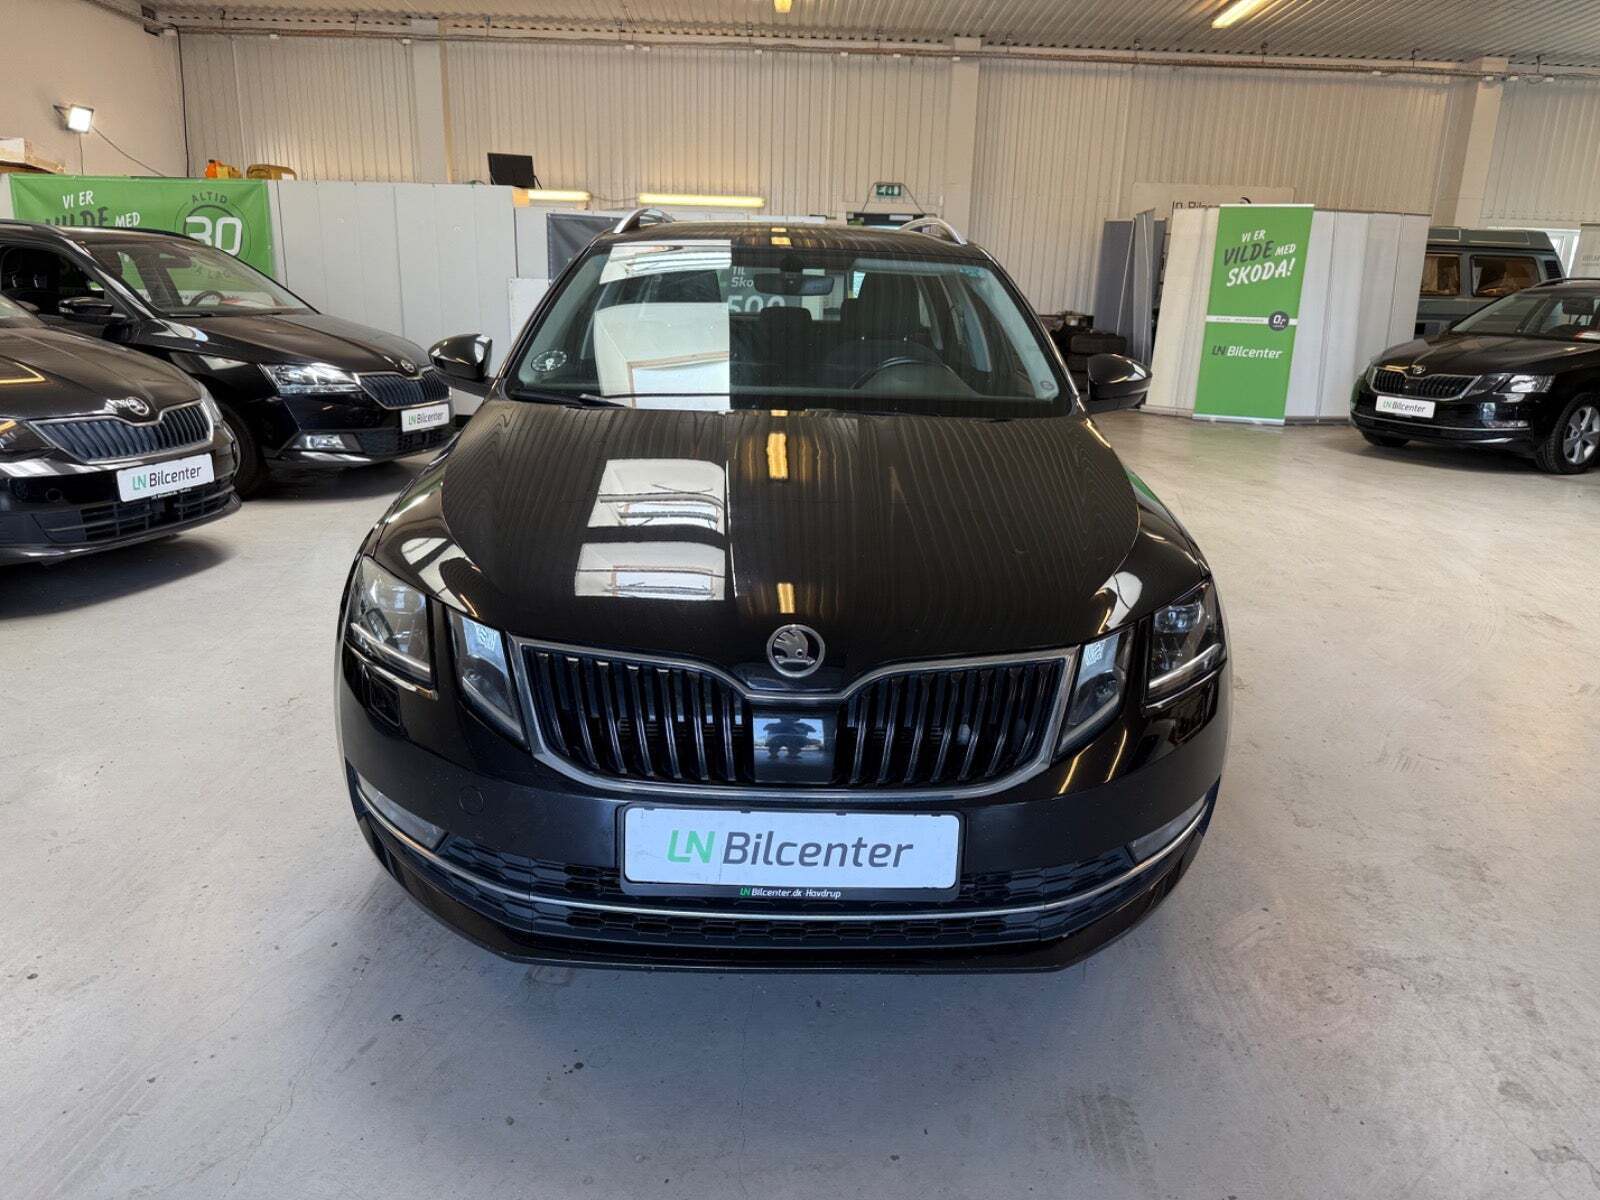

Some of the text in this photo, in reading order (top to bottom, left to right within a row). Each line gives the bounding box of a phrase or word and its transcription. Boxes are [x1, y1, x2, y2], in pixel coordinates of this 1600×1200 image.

[62, 190, 94, 209] VI ER
[192, 191, 228, 204] ALTID
[115, 211, 141, 228] MED
[186, 216, 242, 256] 30
[1242, 229, 1266, 243] VI ER
[1223, 240, 1296, 266] VILDE MED
[1226, 258, 1296, 287] SKODA!
[1227, 345, 1283, 359] Bilcenter
[149, 466, 202, 487] Bilcenter
[666, 829, 914, 868] LN Bilcenter
